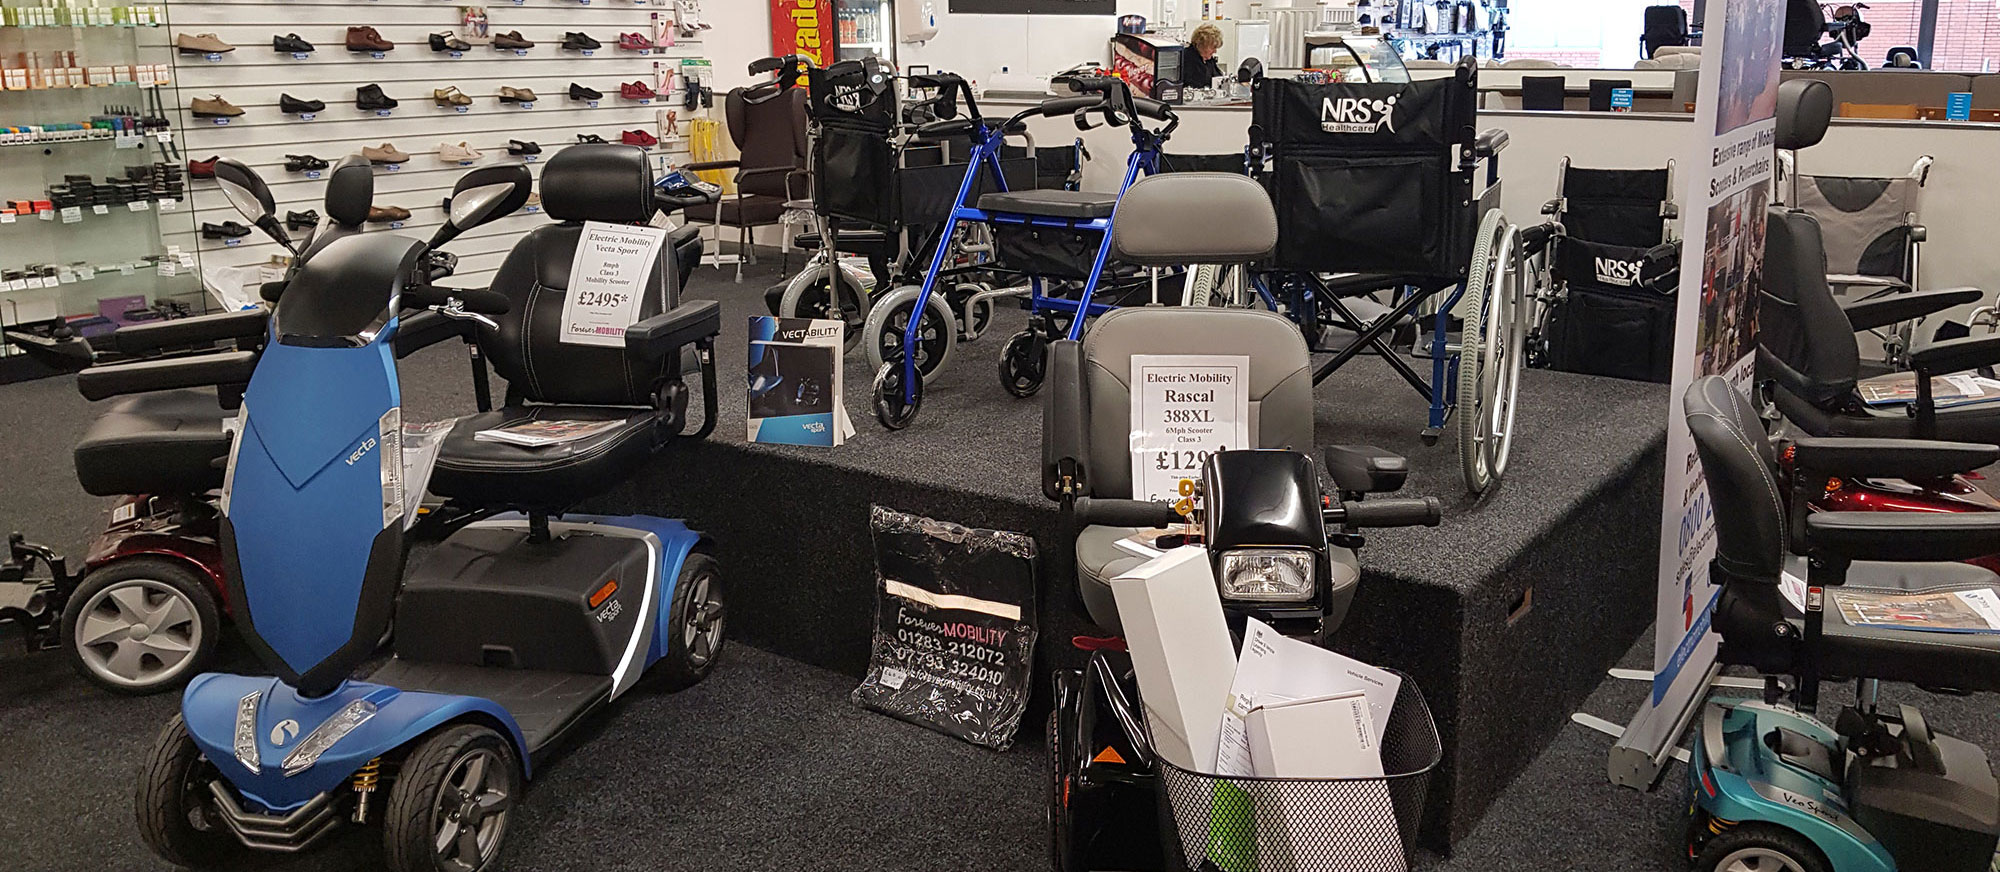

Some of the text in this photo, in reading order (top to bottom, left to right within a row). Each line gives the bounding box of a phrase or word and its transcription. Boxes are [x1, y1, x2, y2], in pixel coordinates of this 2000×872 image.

[1321, 97, 1372, 123] NRS
[1322, 124, 1374, 132] Healthcare
[1737, 138, 1752, 158] range
[1752, 132, 1758, 150] of
[1709, 156, 1769, 198] Scooters & Powerchairs
[589, 233, 651, 248] Electric Mobility
[596, 244, 639, 255] Vecta Sport
[1595, 256, 1628, 279] NRS
[585, 277, 630, 286] Mobility Scooter
[782, 327, 839, 339] VECTABILITY
[1147, 373, 1232, 385] Electric Mobility
[1165, 389, 1214, 403] Rascal
[1163, 409, 1214, 423] 388XL
[802, 421, 824, 430] vecta
[811, 426, 825, 434] sport
[1165, 427, 1186, 435] 6Mph
[345, 437, 377, 466] vecta
[1678, 491, 1704, 557] 0800
[596, 600, 619, 623] vecta
[898, 628, 1005, 666] 01283 212072
[950, 660, 1003, 685] 324010
[1346, 669, 1384, 687] Vehicle Services
[1783, 792, 1805, 806] Veo
